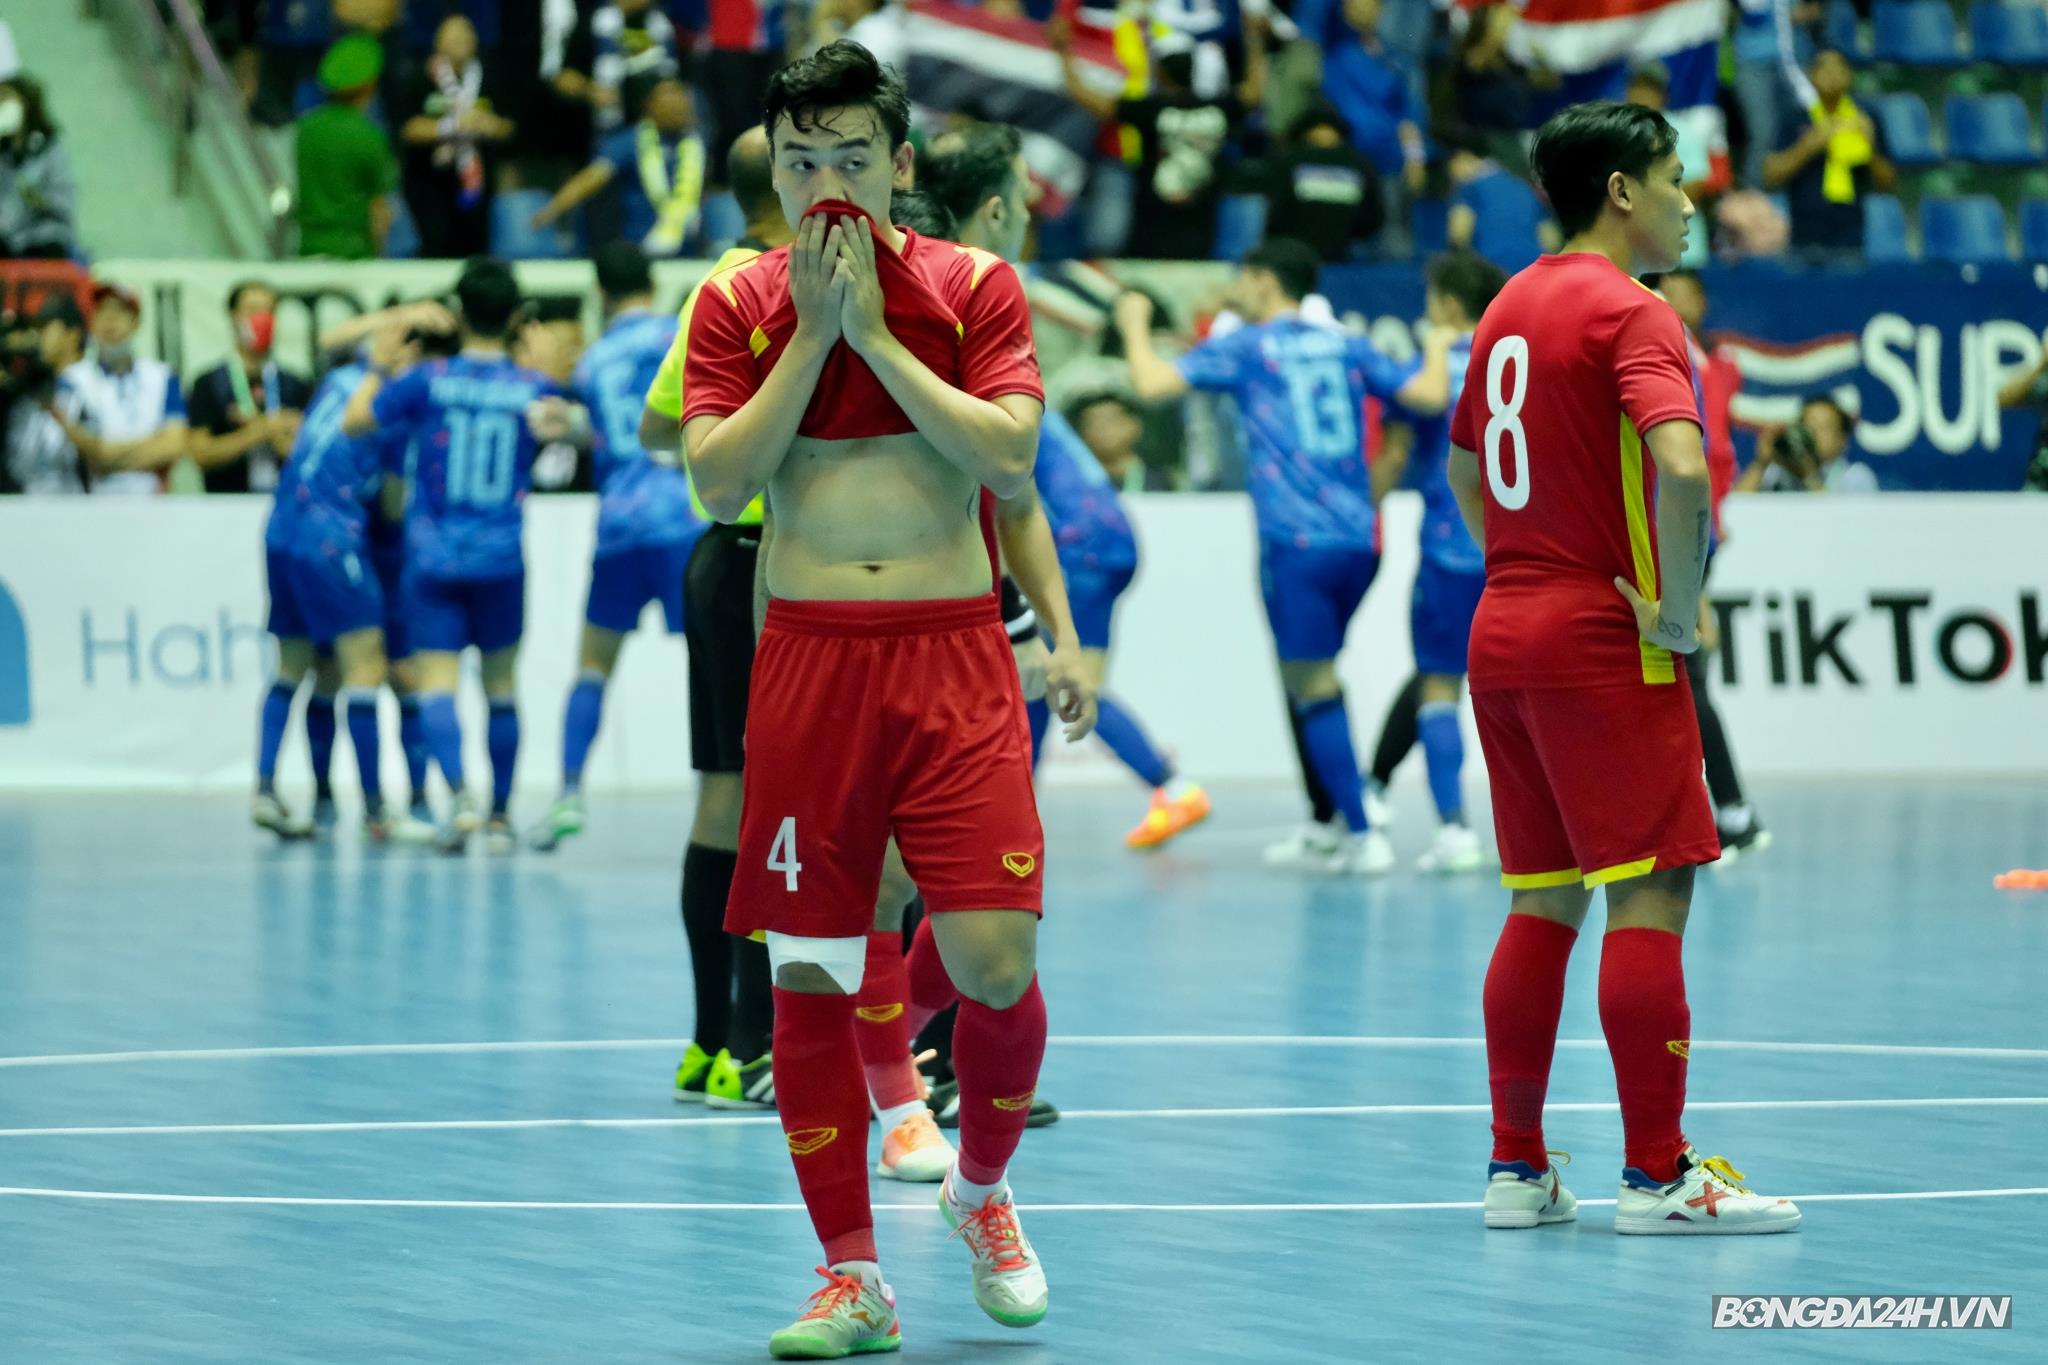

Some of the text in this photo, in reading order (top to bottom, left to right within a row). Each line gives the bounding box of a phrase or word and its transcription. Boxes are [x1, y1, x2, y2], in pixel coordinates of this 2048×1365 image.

[1484, 335, 1530, 510] 8
[1855, 312, 2048, 453] SUP
[443, 407, 517, 504] 10
[767, 816, 802, 891] 4
